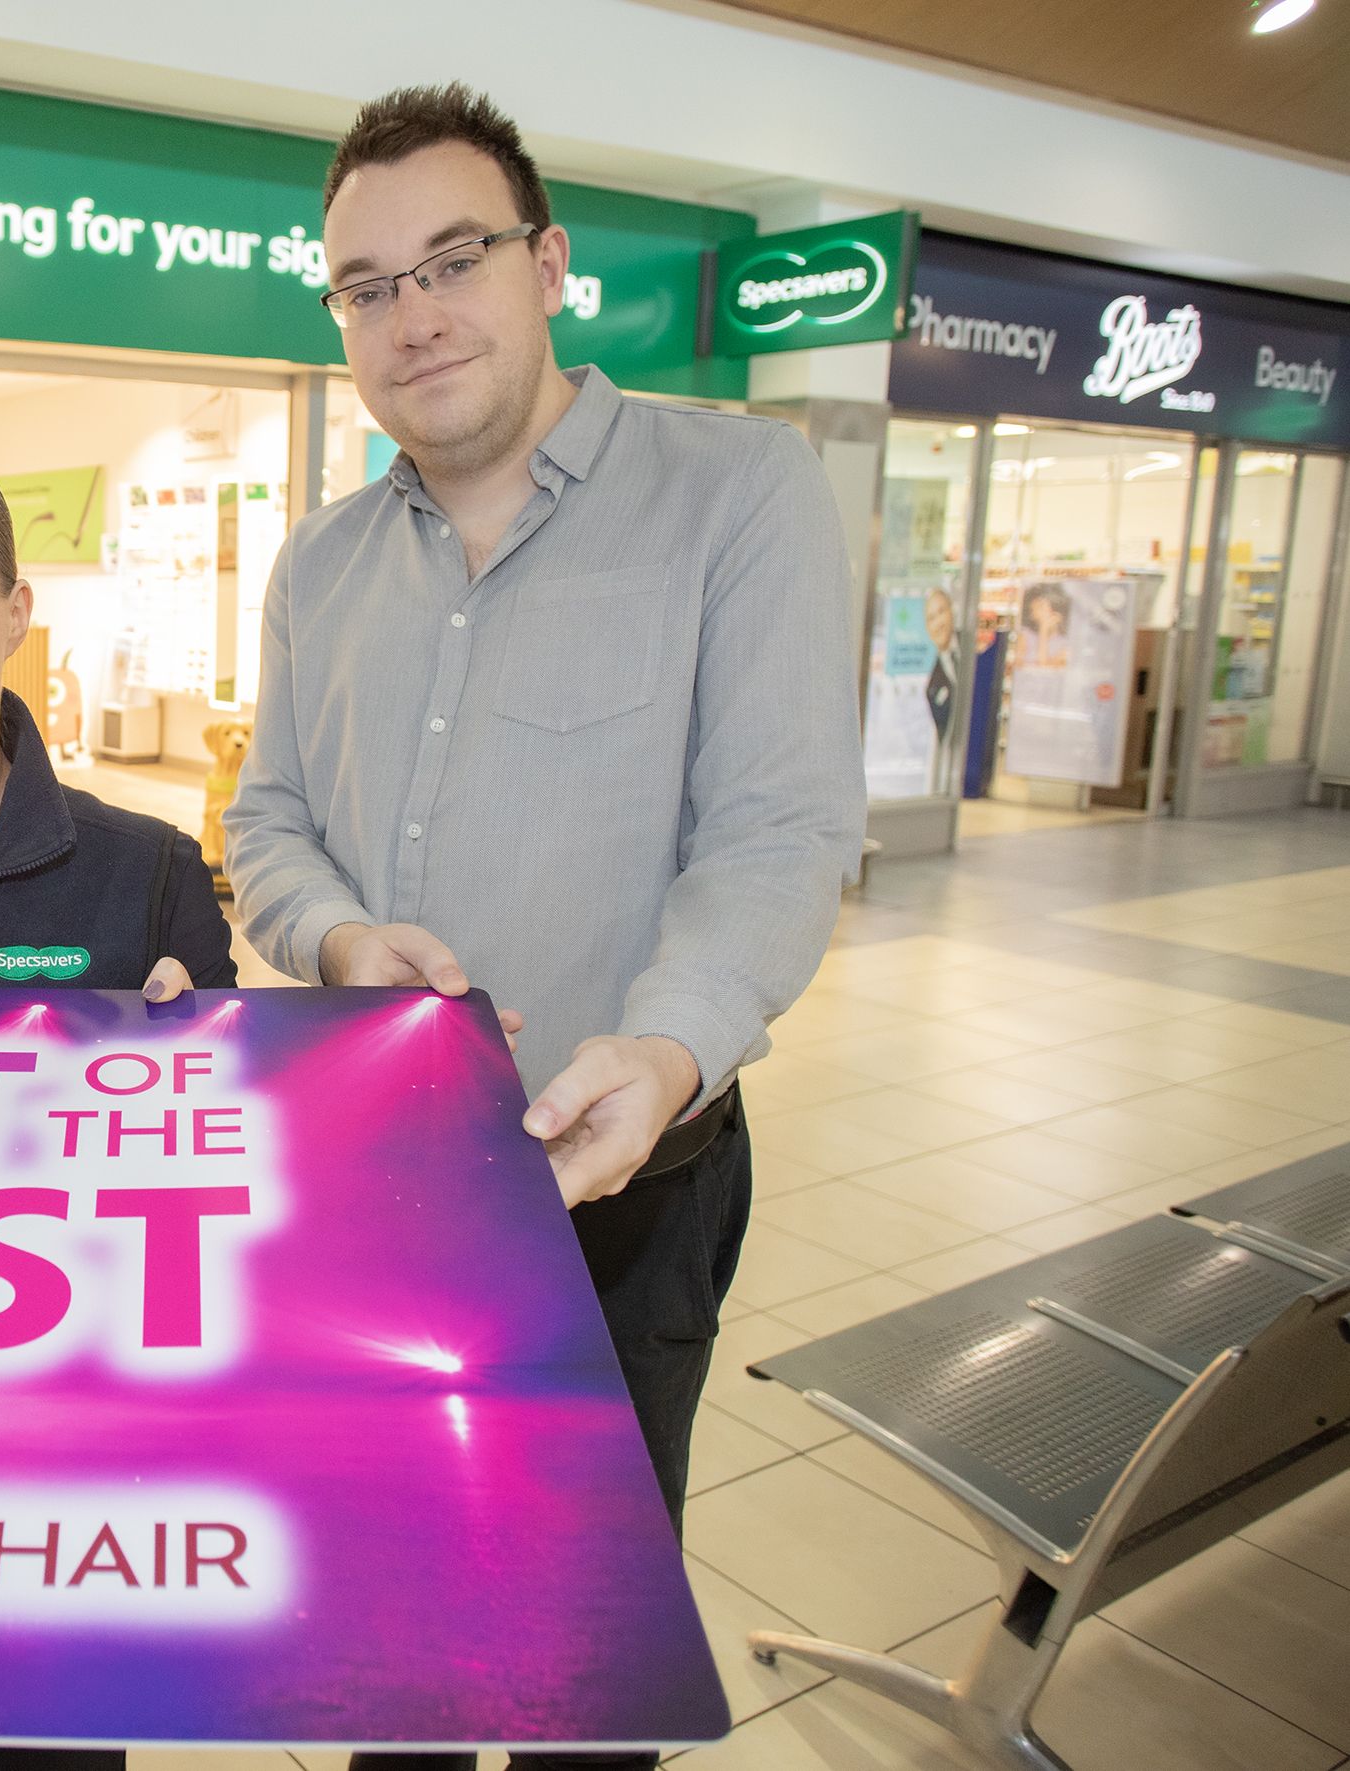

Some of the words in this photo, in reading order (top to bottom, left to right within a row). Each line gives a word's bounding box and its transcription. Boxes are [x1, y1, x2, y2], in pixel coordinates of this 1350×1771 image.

[67, 197, 145, 256] for
[152, 221, 262, 271] your
[738, 266, 867, 310] Specsavers
[1083, 295, 1202, 404] Boots
[1255, 345, 1336, 407] Beauty
[84, 1051, 213, 1096] OF
[47, 1107, 246, 1158] THE
